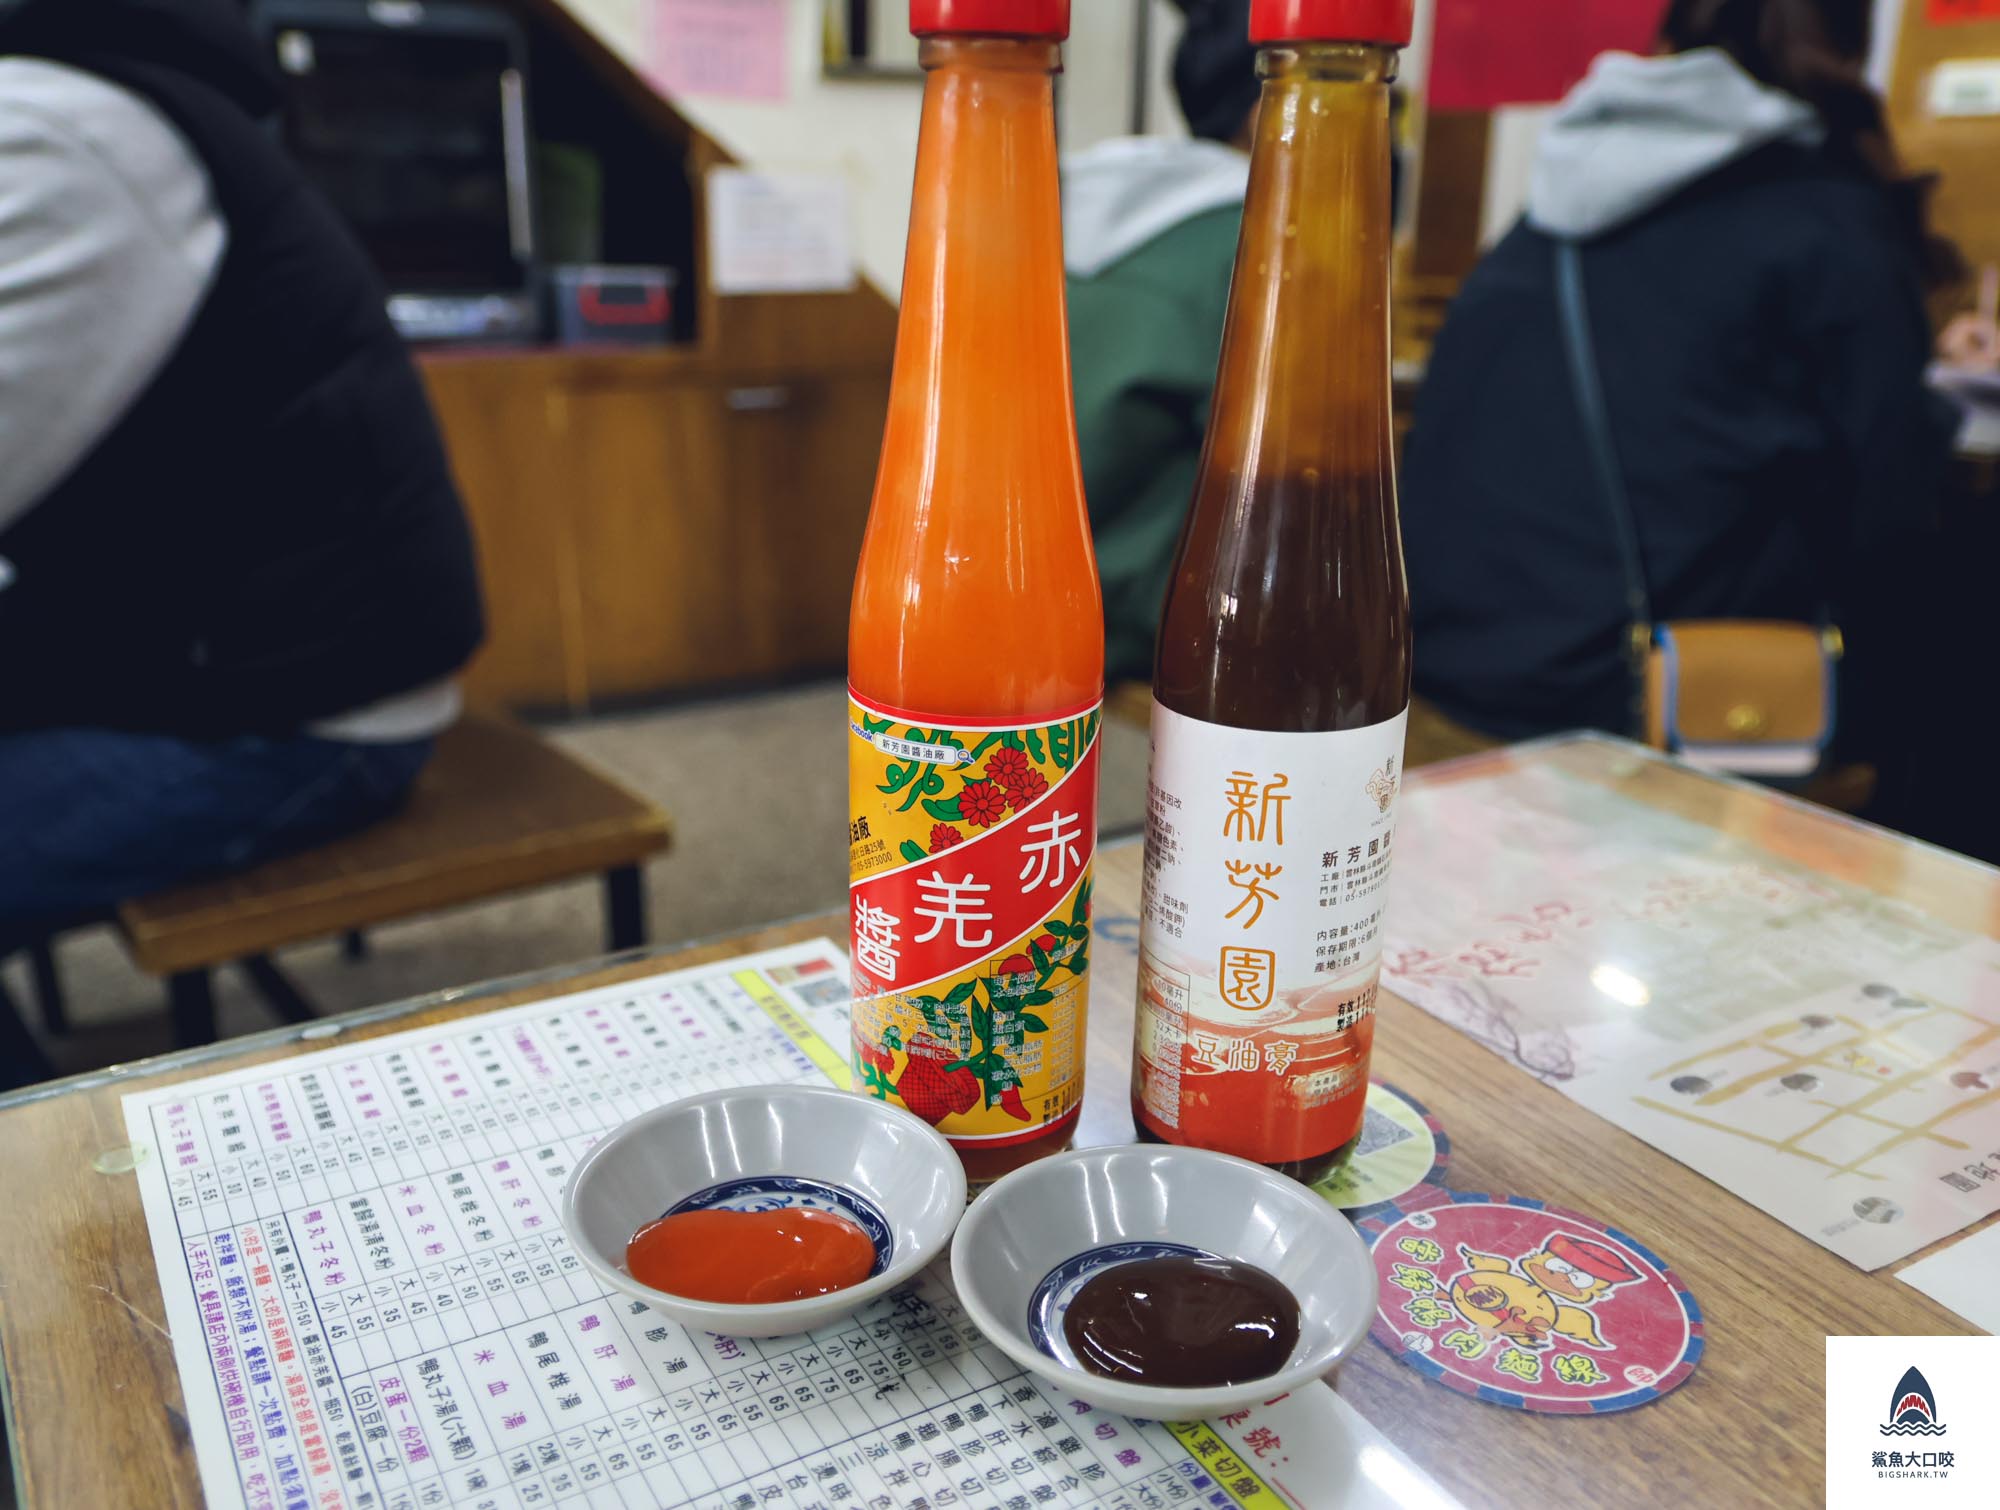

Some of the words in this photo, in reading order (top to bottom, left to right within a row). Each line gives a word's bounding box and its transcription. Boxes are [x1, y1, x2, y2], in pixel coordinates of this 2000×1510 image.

[1191, 1032, 1299, 1076] 豆油膏
[500, 1250, 518, 1261] 大
[511, 1271, 529, 1285] 65
[524, 1243, 543, 1253] 小
[536, 1263, 554, 1277] 55
[548, 1235, 566, 1247] 大
[561, 1256, 579, 1269] 65
[425, 1271, 444, 1282] 小
[436, 1293, 453, 1308] 40
[451, 1263, 469, 1276] 大
[462, 1286, 480, 1300] 50
[476, 1257, 494, 1267] 小
[486, 1278, 505, 1292] 55
[321, 1301, 341, 1313] 小
[347, 1294, 366, 1306] 大
[374, 1287, 392, 1297] 小
[383, 1308, 401, 1322] 35
[400, 1279, 418, 1291] 大
[411, 1301, 428, 1316] 45
[329, 1325, 348, 1339] 45
[356, 1316, 375, 1331] 55
[938, 1335, 959, 1350] 55
[578, 1314, 636, 1392] 鴨肝湯
[827, 1345, 846, 1358] 小
[844, 1368, 864, 1385] 65
[849, 1336, 868, 1351] 大
[868, 1359, 888, 1376] 75
[915, 1343, 936, 1358] 70
[473, 1349, 527, 1430] 米血湯
[752, 1370, 771, 1385] 大
[769, 1395, 789, 1412] 65
[778, 1362, 796, 1375] 小
[794, 1385, 815, 1403] 65
[800, 1352, 820, 1367] 大
[819, 1376, 840, 1393] 75
[377, 1376, 431, 1464] 皮蛋一份2顆
[675, 1398, 692, 1411] 小
[690, 1423, 711, 1442] 55
[701, 1387, 720, 1403] 大
[717, 1413, 738, 1431] 65
[727, 1380, 745, 1393] 小
[743, 1404, 764, 1422] 55
[350, 1385, 400, 1474] (白)豆腐一份
[592, 1426, 614, 1441] 大
[608, 1453, 629, 1471] 65
[621, 1417, 641, 1430] 小
[636, 1443, 656, 1461] 55
[647, 1407, 668, 1422] 大
[664, 1433, 684, 1451] 65
[995, 1394, 1080, 1491] 下水綜合
[1012, 1385, 1105, 1482] 香滷雞胗
[566, 1436, 586, 1449] 小
[580, 1463, 601, 1481] 55
[915, 1422, 1000, 1510] 鵝腸切
[969, 1404, 1057, 1504] 鴨肝切盤
[1176, 1421, 1261, 1498] 小菜切盤
[521, 1484, 543, 1502] 25
[1157, 1473, 1189, 1499] 小份
